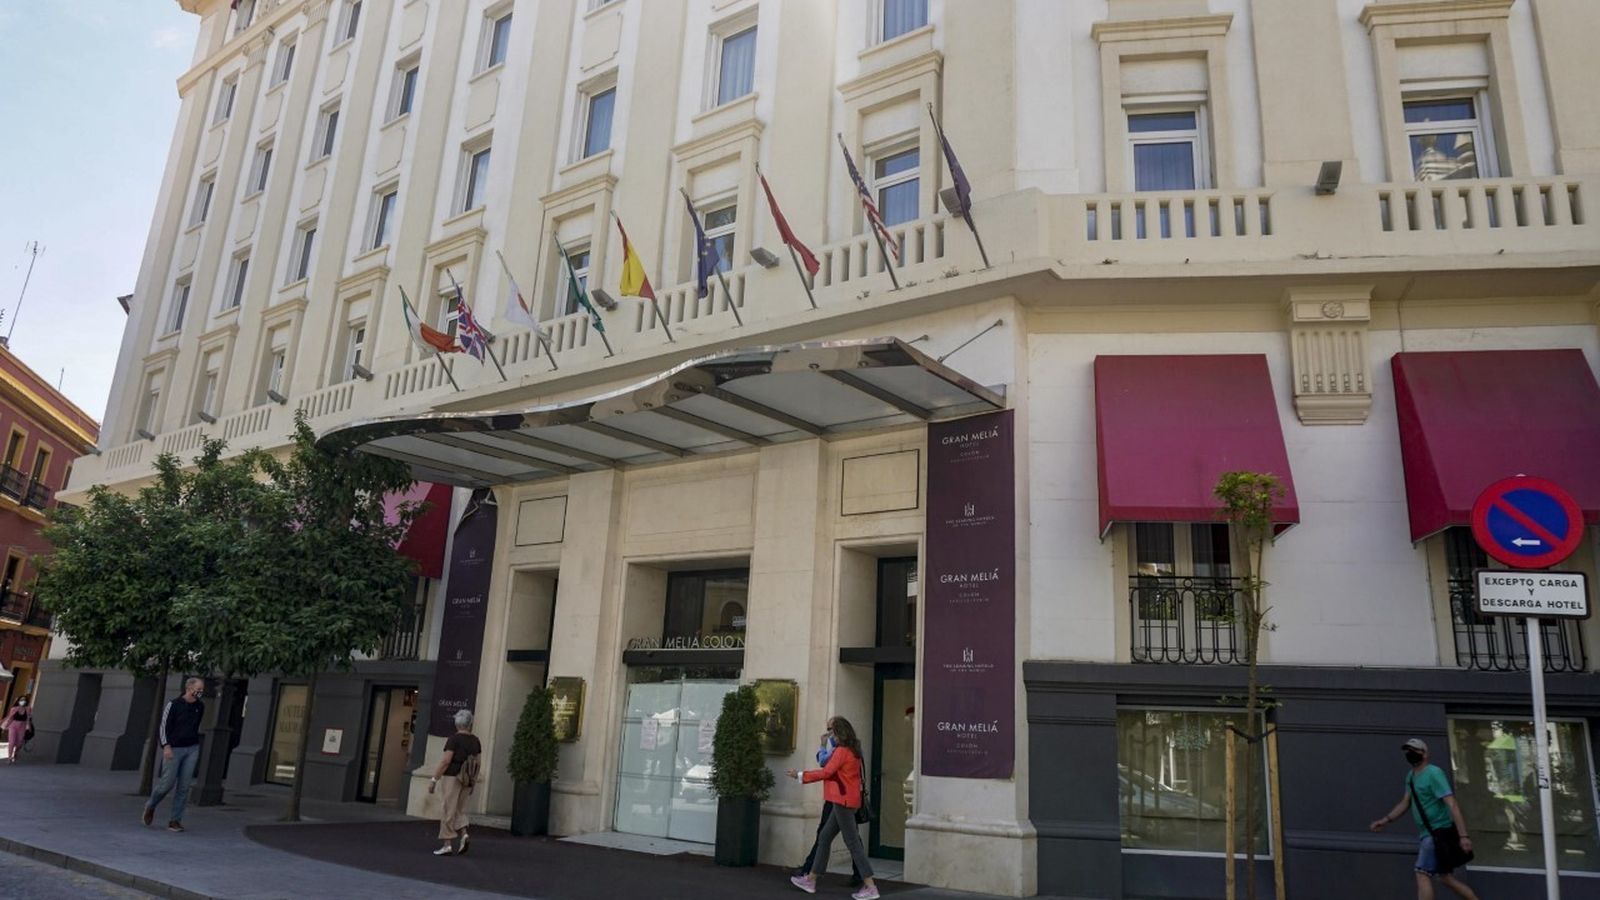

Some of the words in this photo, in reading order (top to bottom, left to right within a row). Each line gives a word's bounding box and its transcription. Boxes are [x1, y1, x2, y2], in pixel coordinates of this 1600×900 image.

[942, 433, 969, 445] GRAN
[971, 425, 998, 440] MELIÁ
[940, 573, 968, 584] GRAN
[970, 568, 999, 582] MELIÁ
[1484, 577, 1534, 586] EXCEPTO
[1539, 579, 1578, 588] CARGA
[1528, 588, 1534, 596] Y
[1482, 598, 1542, 608] DESCARGA
[1547, 600, 1584, 610] HOTEL
[937, 721, 966, 731] GRAN
[969, 719, 999, 733] MELIÁ
